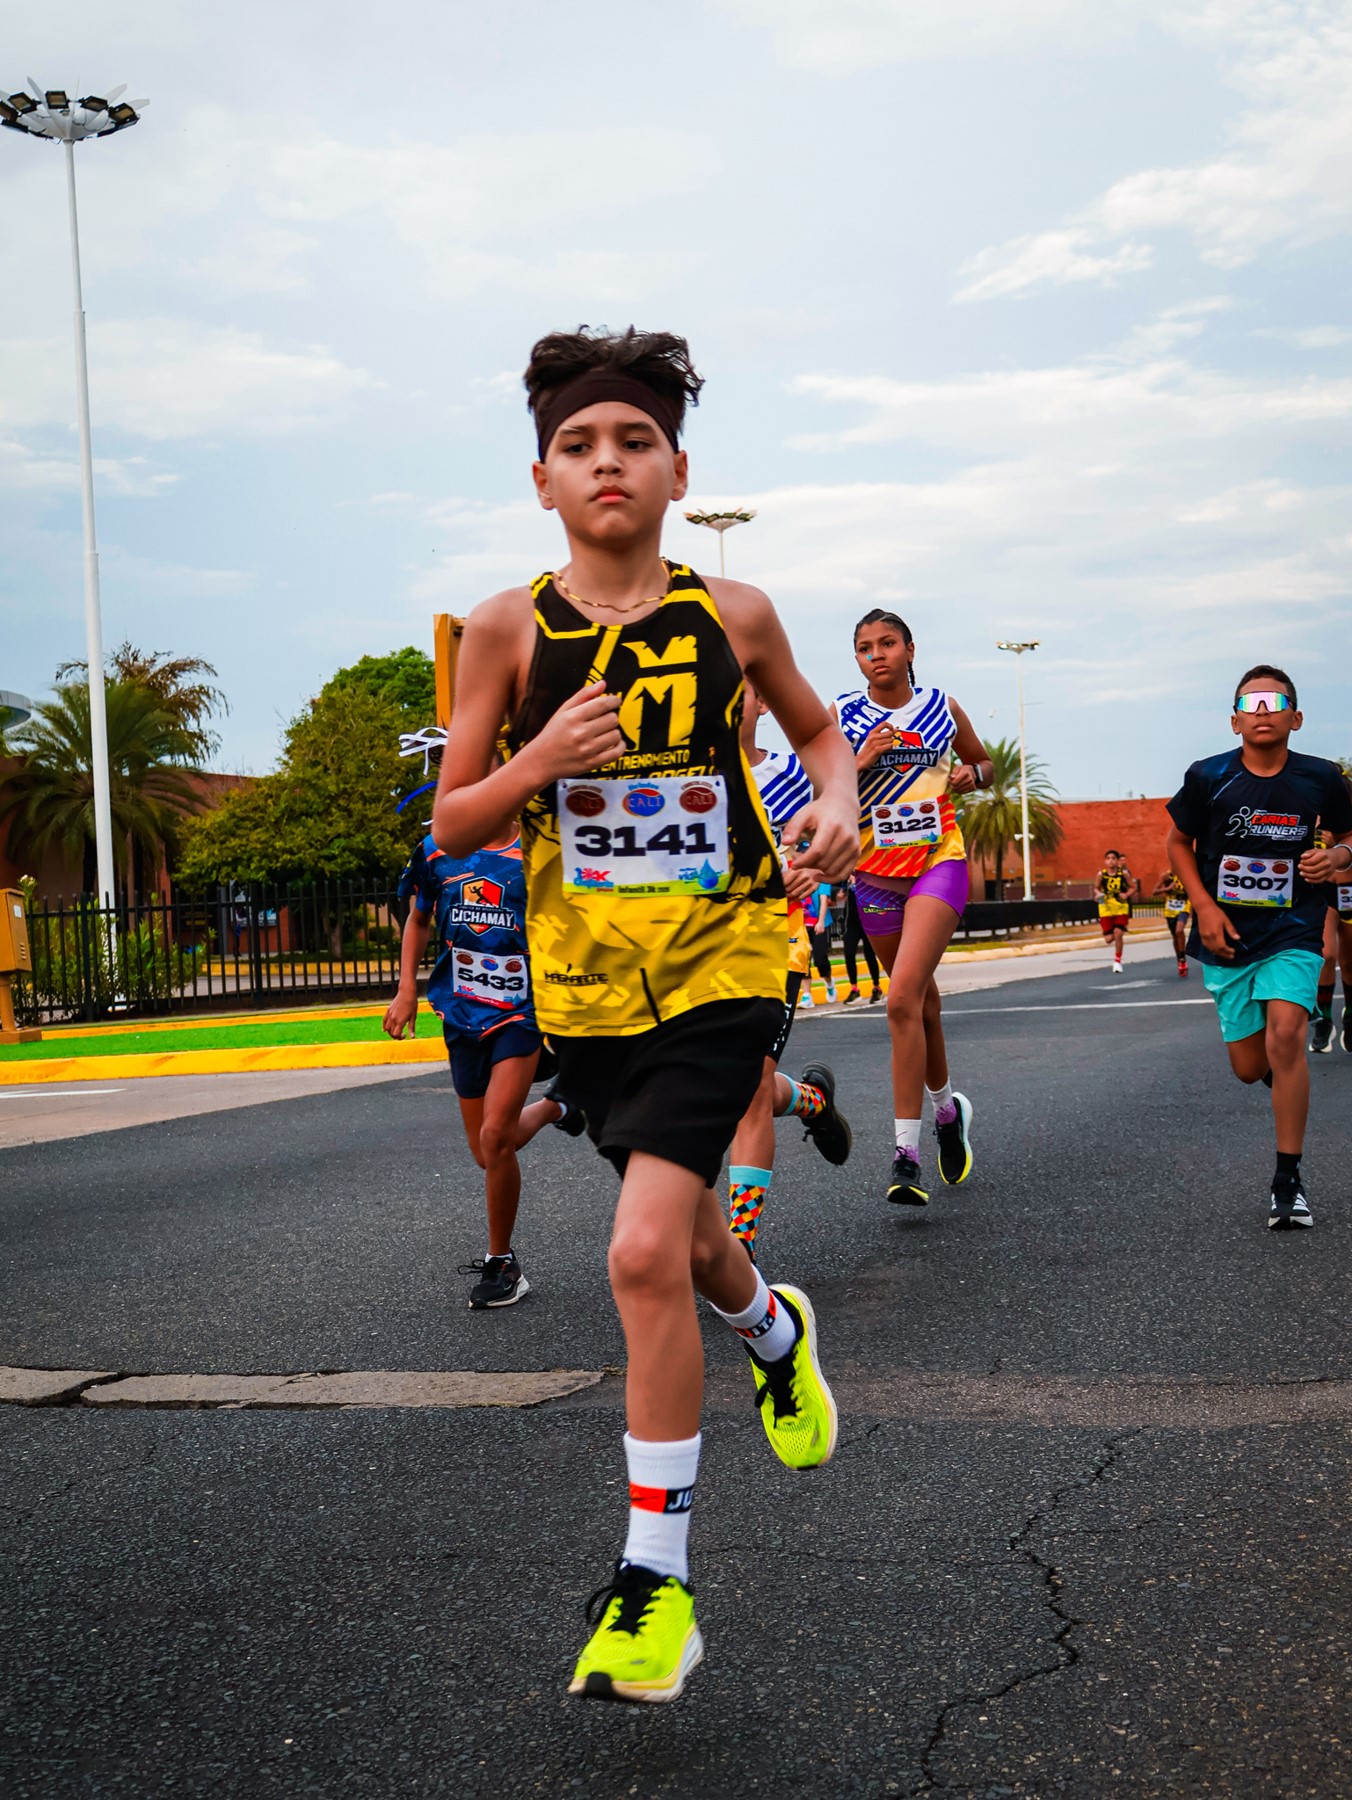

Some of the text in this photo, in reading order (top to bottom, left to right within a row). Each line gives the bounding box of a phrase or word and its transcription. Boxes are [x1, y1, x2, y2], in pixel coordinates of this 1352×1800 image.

[627, 797, 661, 808] CALI
[878, 816, 937, 834] 3122
[1251, 814, 1298, 826] CARIAS
[1249, 825, 1307, 836] RUNNERS
[574, 823, 716, 857] 3141
[1223, 873, 1289, 891] 3007
[457, 967, 524, 991] 5433
